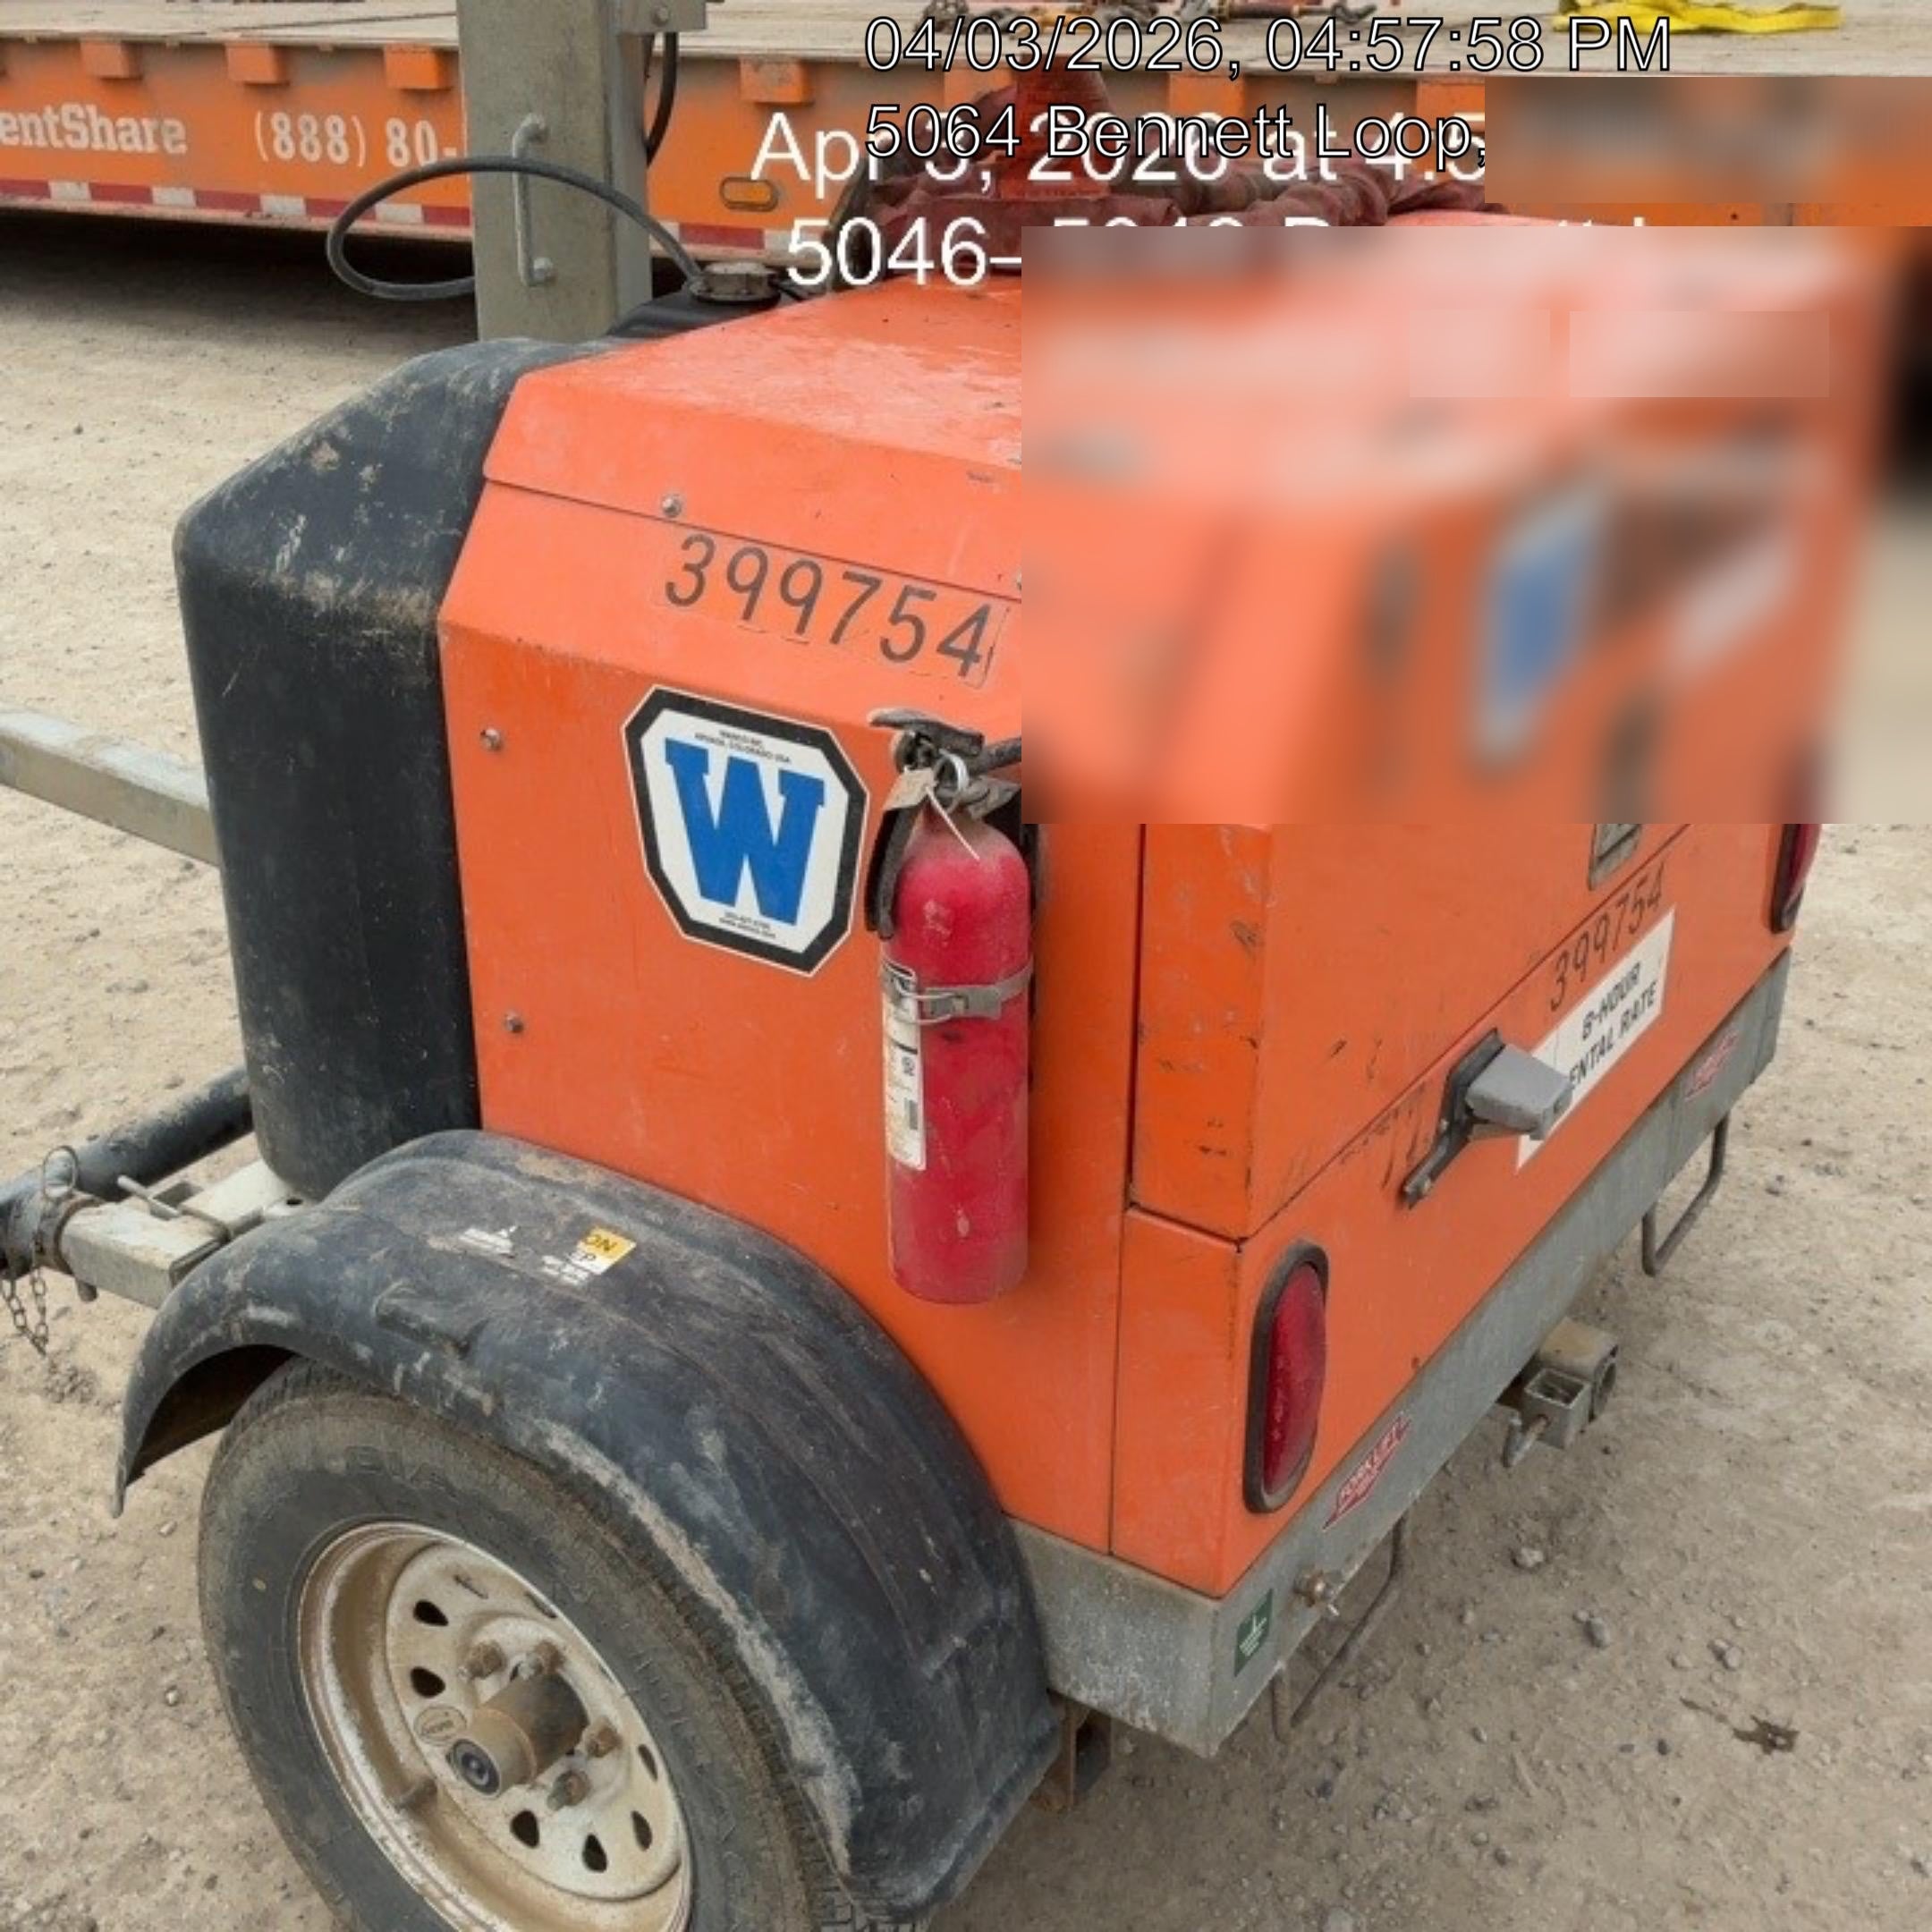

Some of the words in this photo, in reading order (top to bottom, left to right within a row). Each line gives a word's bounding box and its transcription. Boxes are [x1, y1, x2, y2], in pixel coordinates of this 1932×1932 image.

[255, 108, 368, 168] (888)
[665, 533, 992, 678] 399754
[665, 736, 826, 927] W
[1550, 860, 1665, 1013] 399754
[1568, 1033, 1614, 1088] ENTAL
